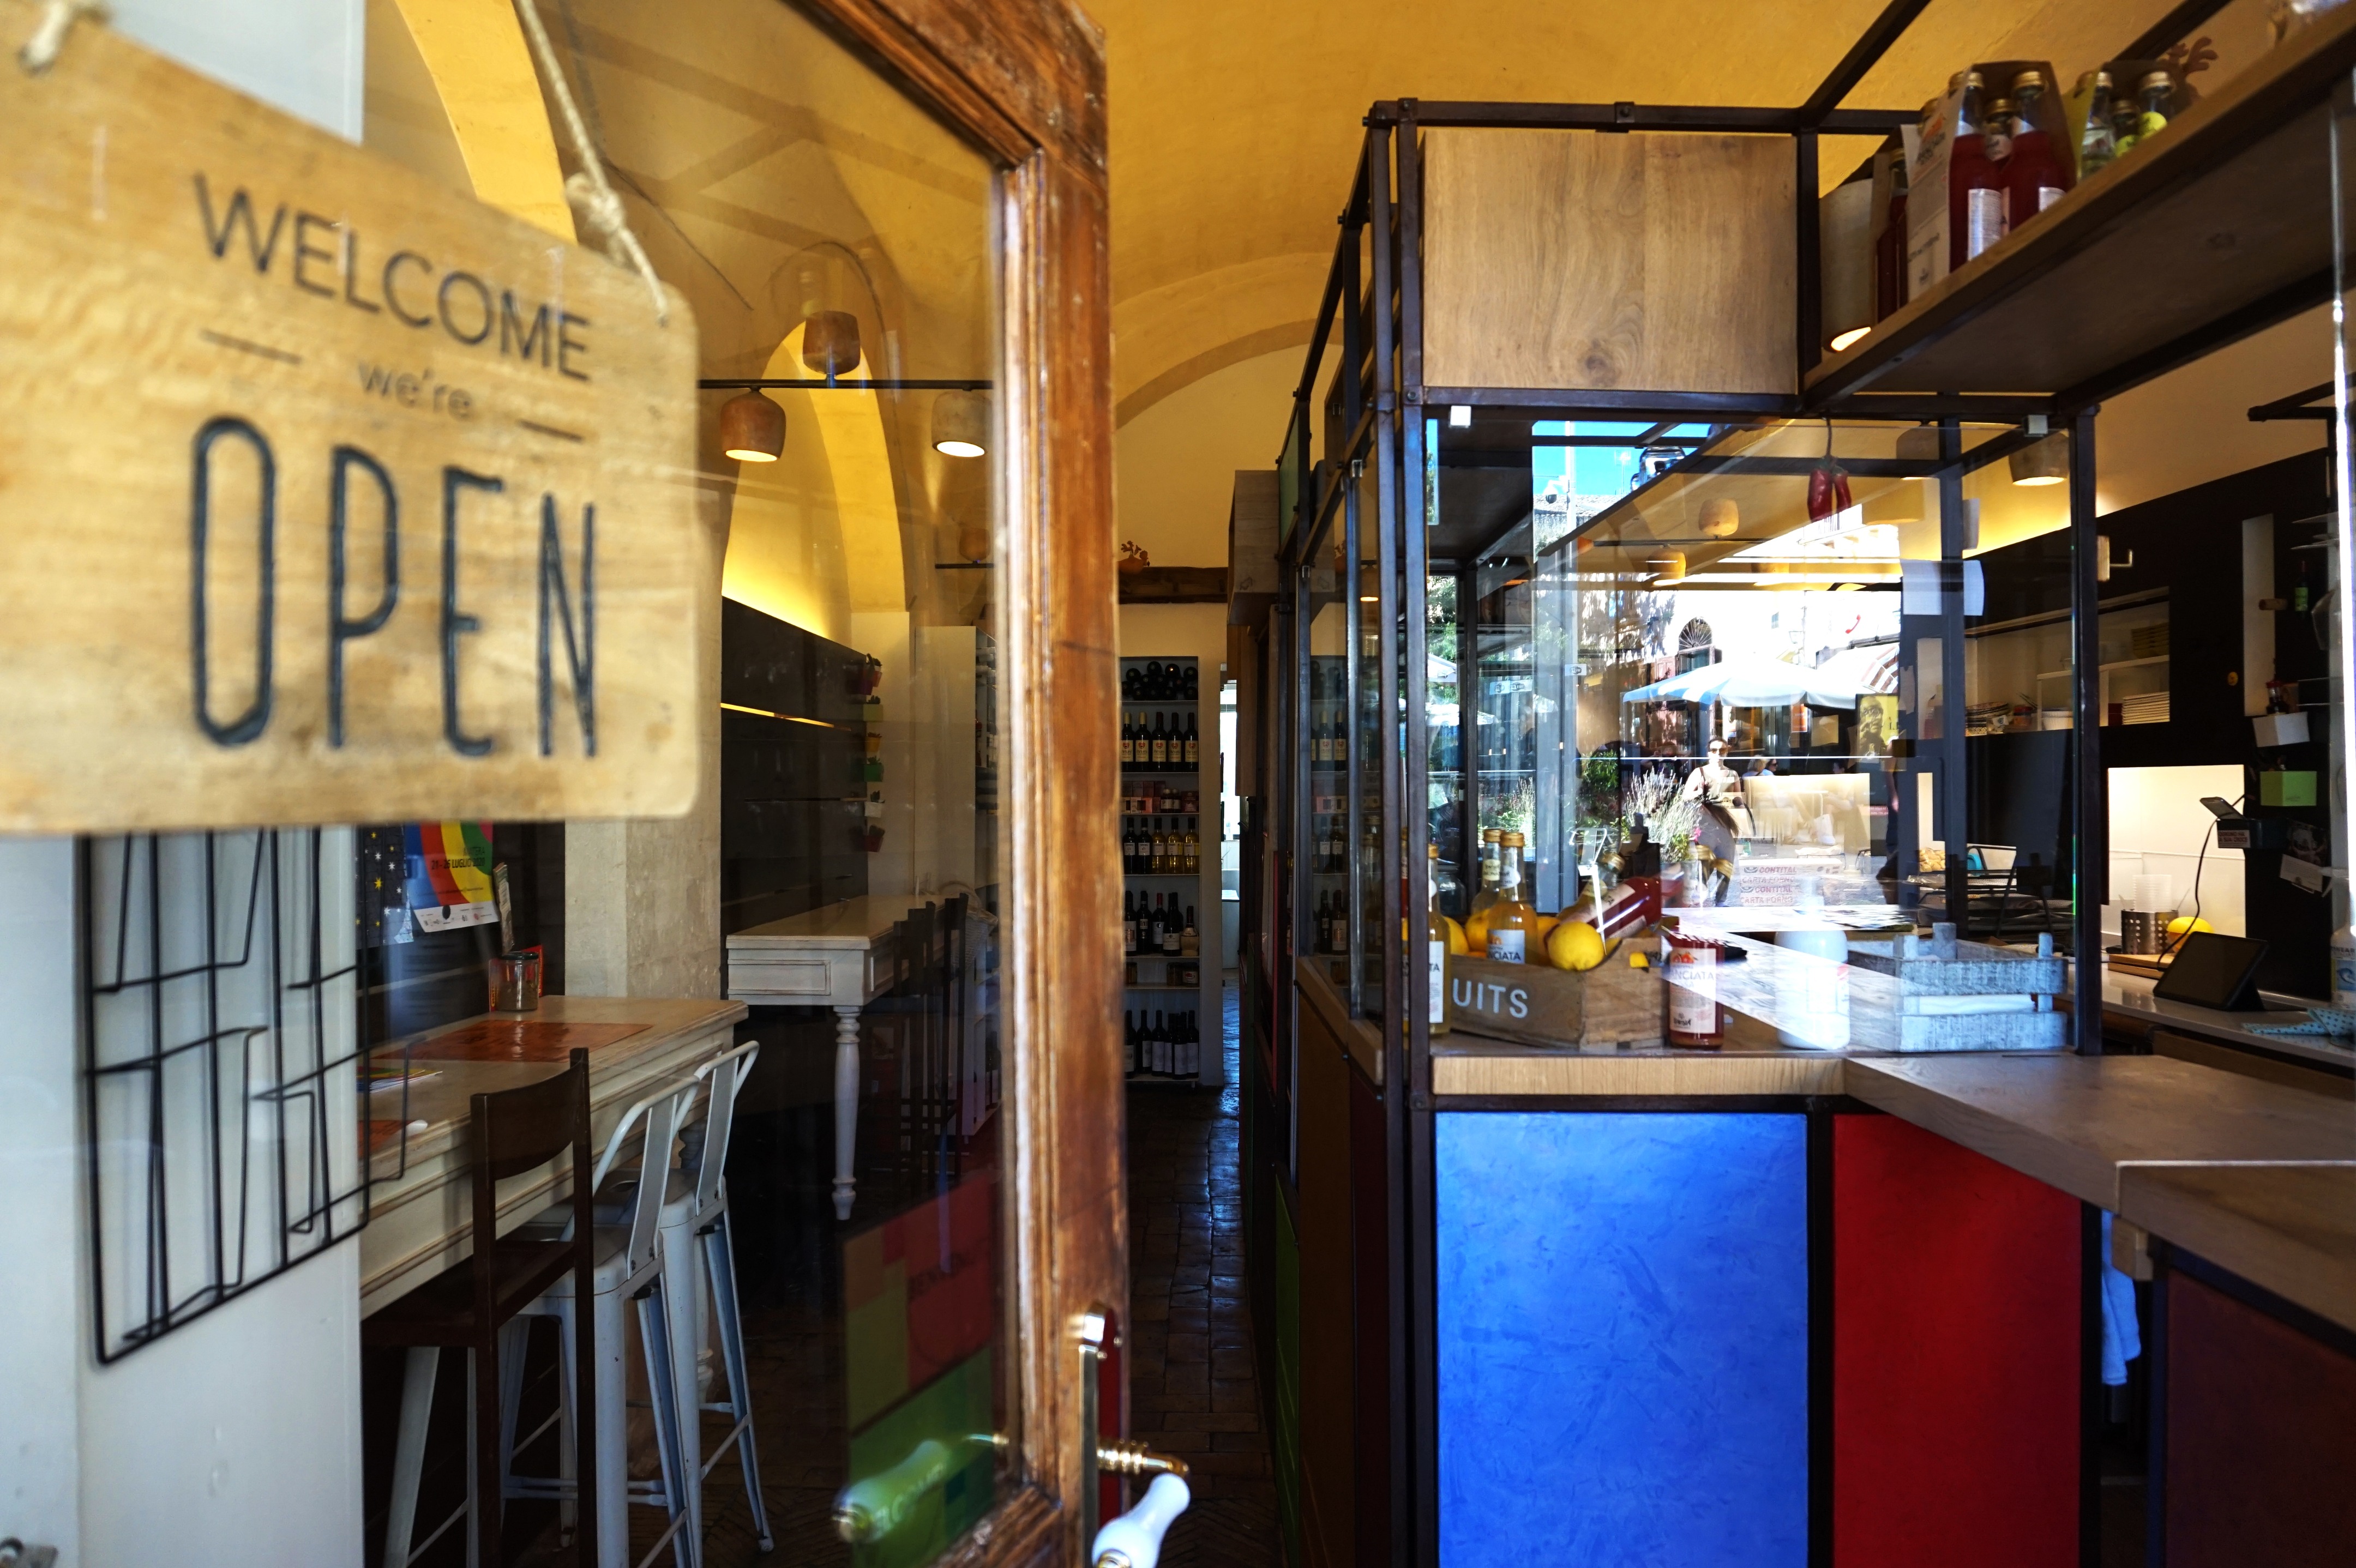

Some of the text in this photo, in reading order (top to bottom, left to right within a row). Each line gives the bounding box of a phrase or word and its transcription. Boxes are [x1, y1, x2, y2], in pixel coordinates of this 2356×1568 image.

[193, 171, 592, 382] WELCOME
[358, 360, 474, 419] we're
[193, 415, 597, 758] OPEN
[452, 858, 472, 868] LUGLIO
[1452, 978, 1528, 1018] UITS
